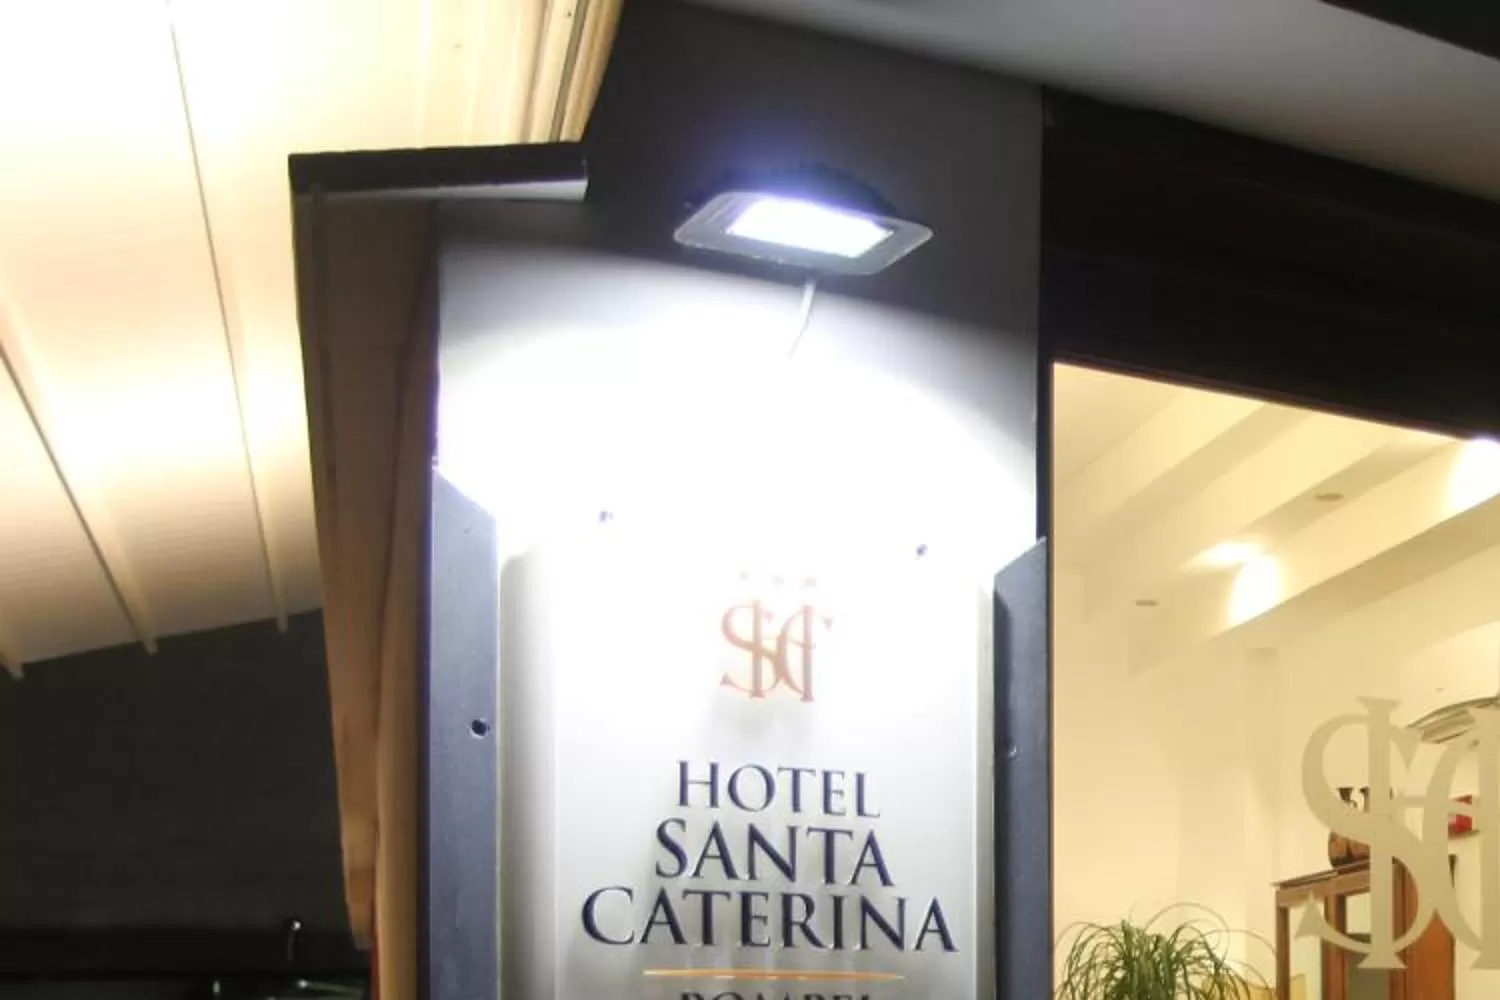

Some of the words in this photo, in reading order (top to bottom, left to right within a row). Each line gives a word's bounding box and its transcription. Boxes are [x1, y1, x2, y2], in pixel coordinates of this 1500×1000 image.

[676, 760, 881, 818] HOTEL
[655, 818, 895, 887] SANTA
[581, 886, 960, 953] CATERINA
